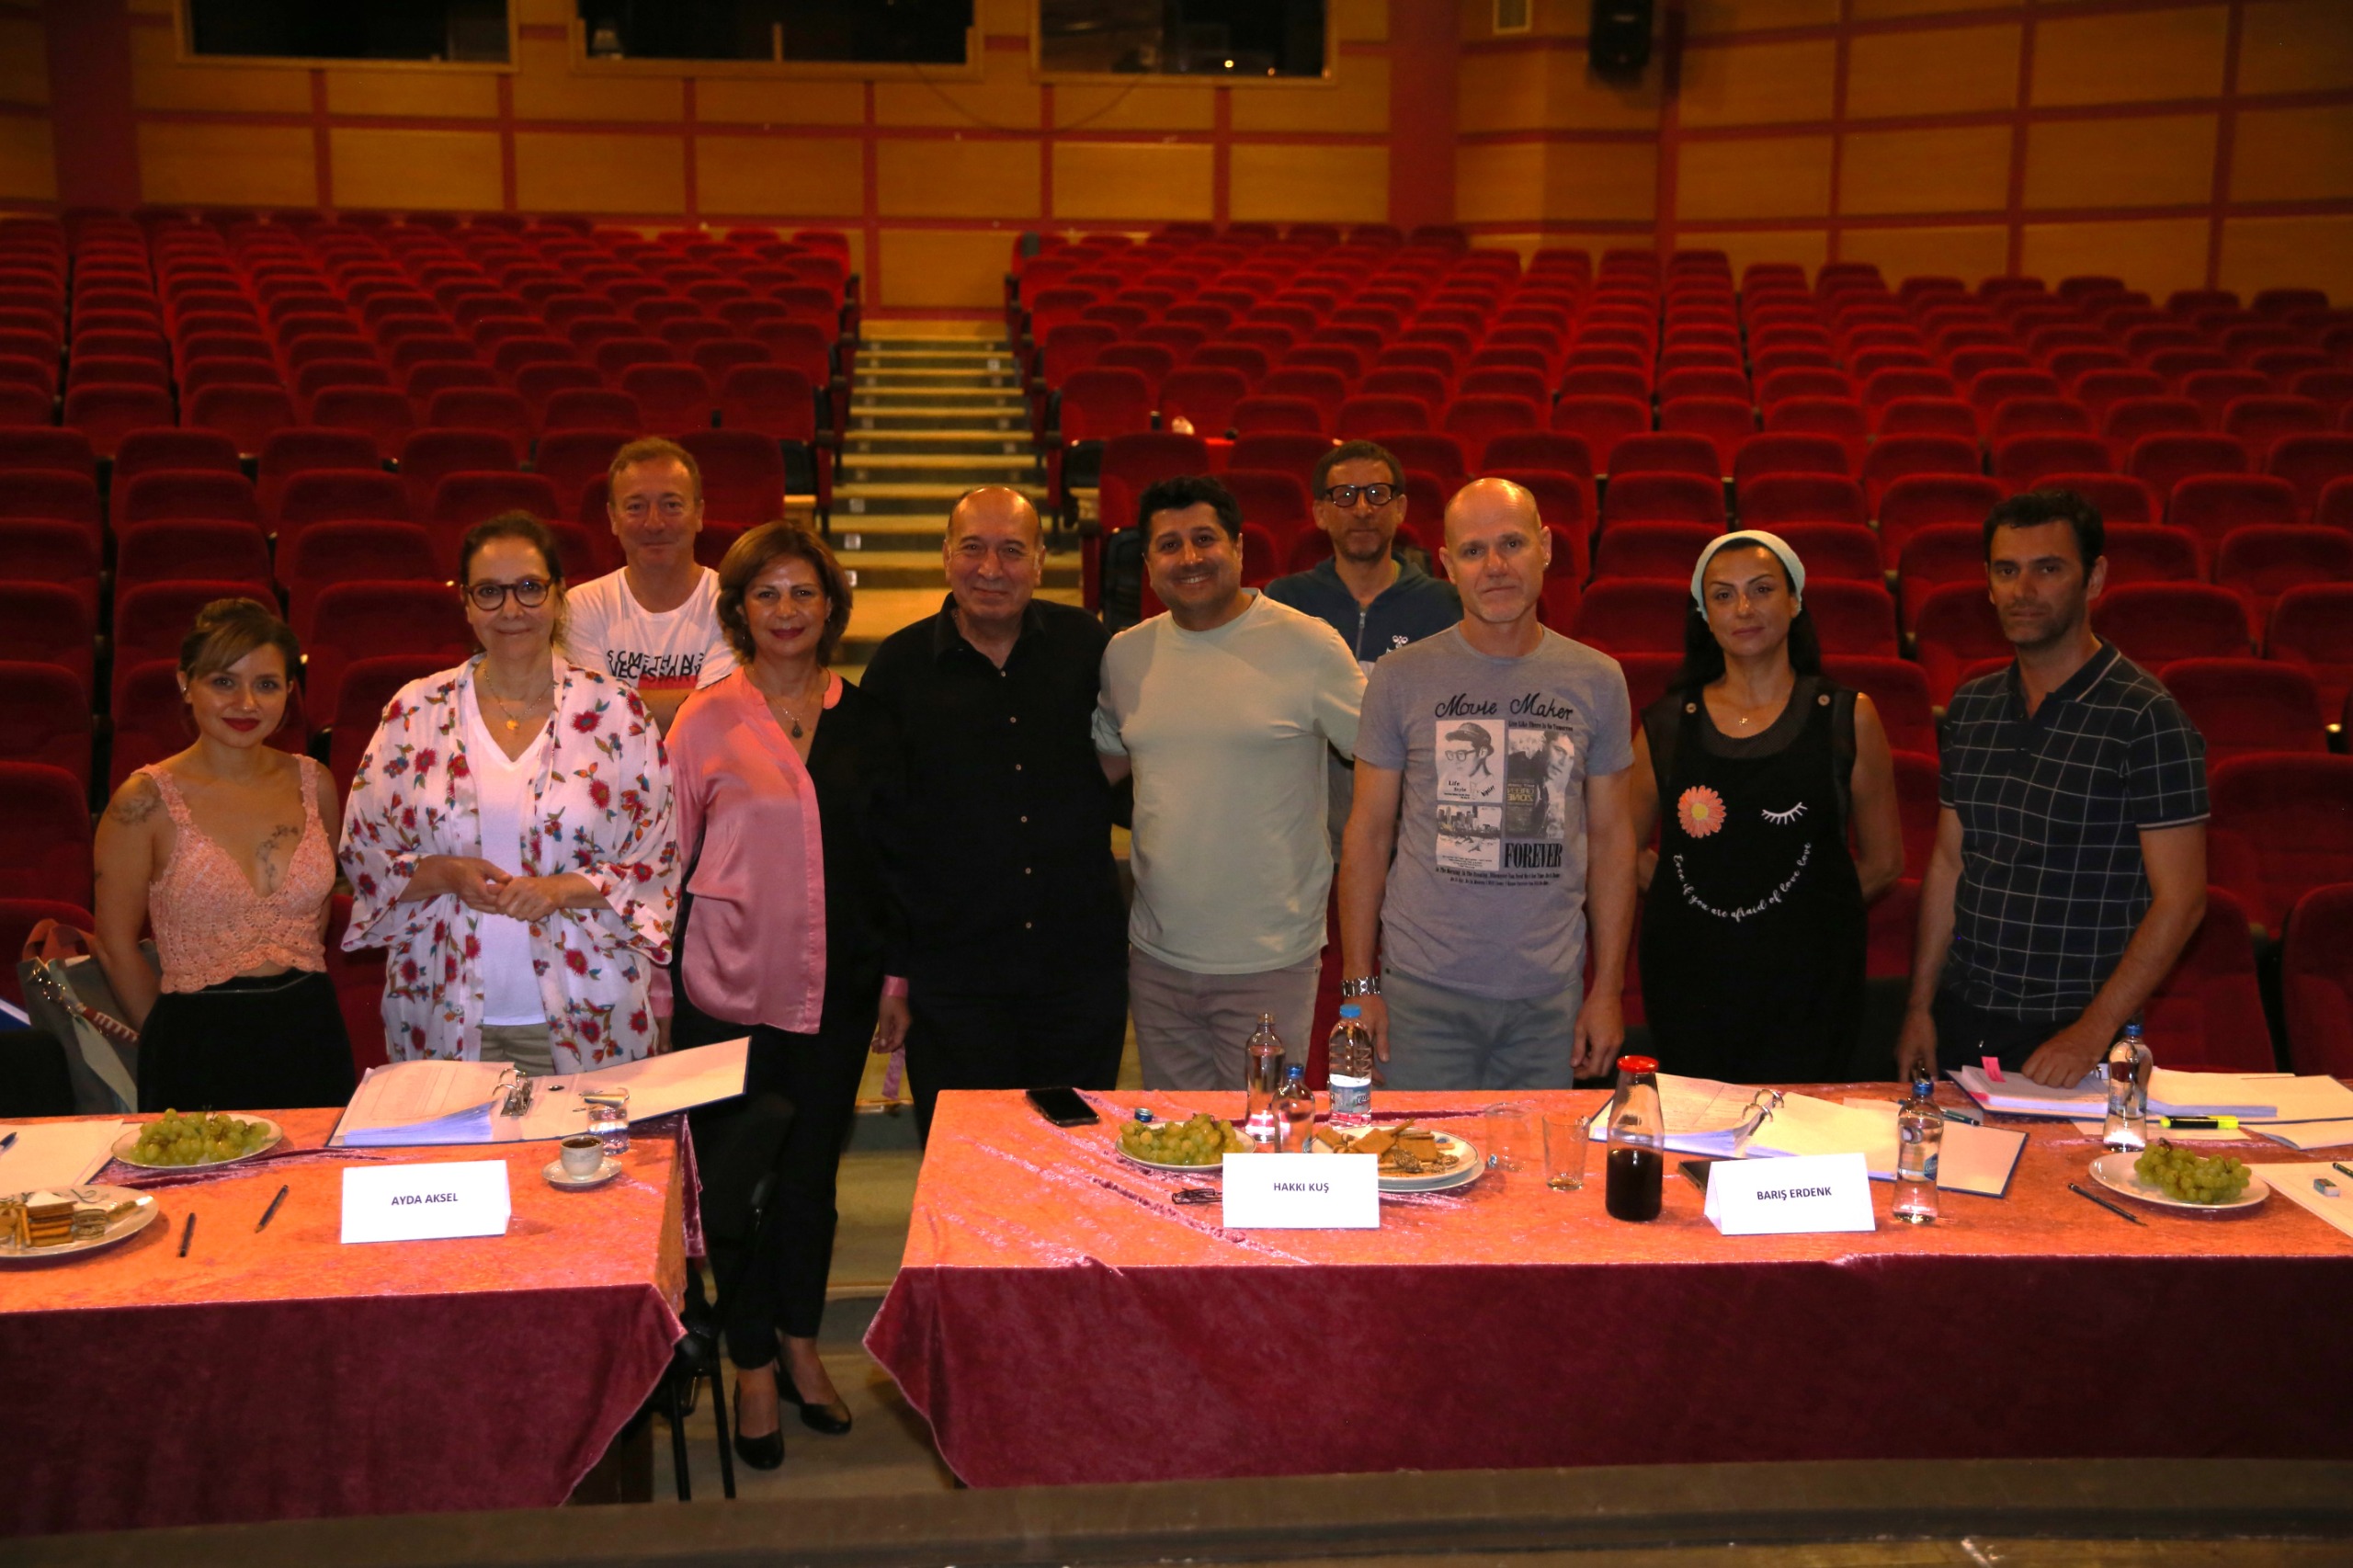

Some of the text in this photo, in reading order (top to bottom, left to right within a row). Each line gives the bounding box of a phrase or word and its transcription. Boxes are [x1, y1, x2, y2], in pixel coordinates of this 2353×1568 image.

[1435, 692, 1574, 721] Movie Maker
[1505, 842, 1563, 869] FOREVER
[1673, 853, 1684, 882] Even
[1688, 893, 1709, 912] you
[1711, 907, 1728, 918] are
[1730, 899, 1767, 923] afraid
[1768, 890, 1782, 903] of
[1779, 869, 1801, 892] love
[1796, 842, 1812, 867] love
[1273, 1182, 1329, 1194] HAKKI KUŞ
[1756, 1186, 1833, 1201] BARIŞ ERDENK
[391, 1192, 459, 1206] AYDA AKSEL
